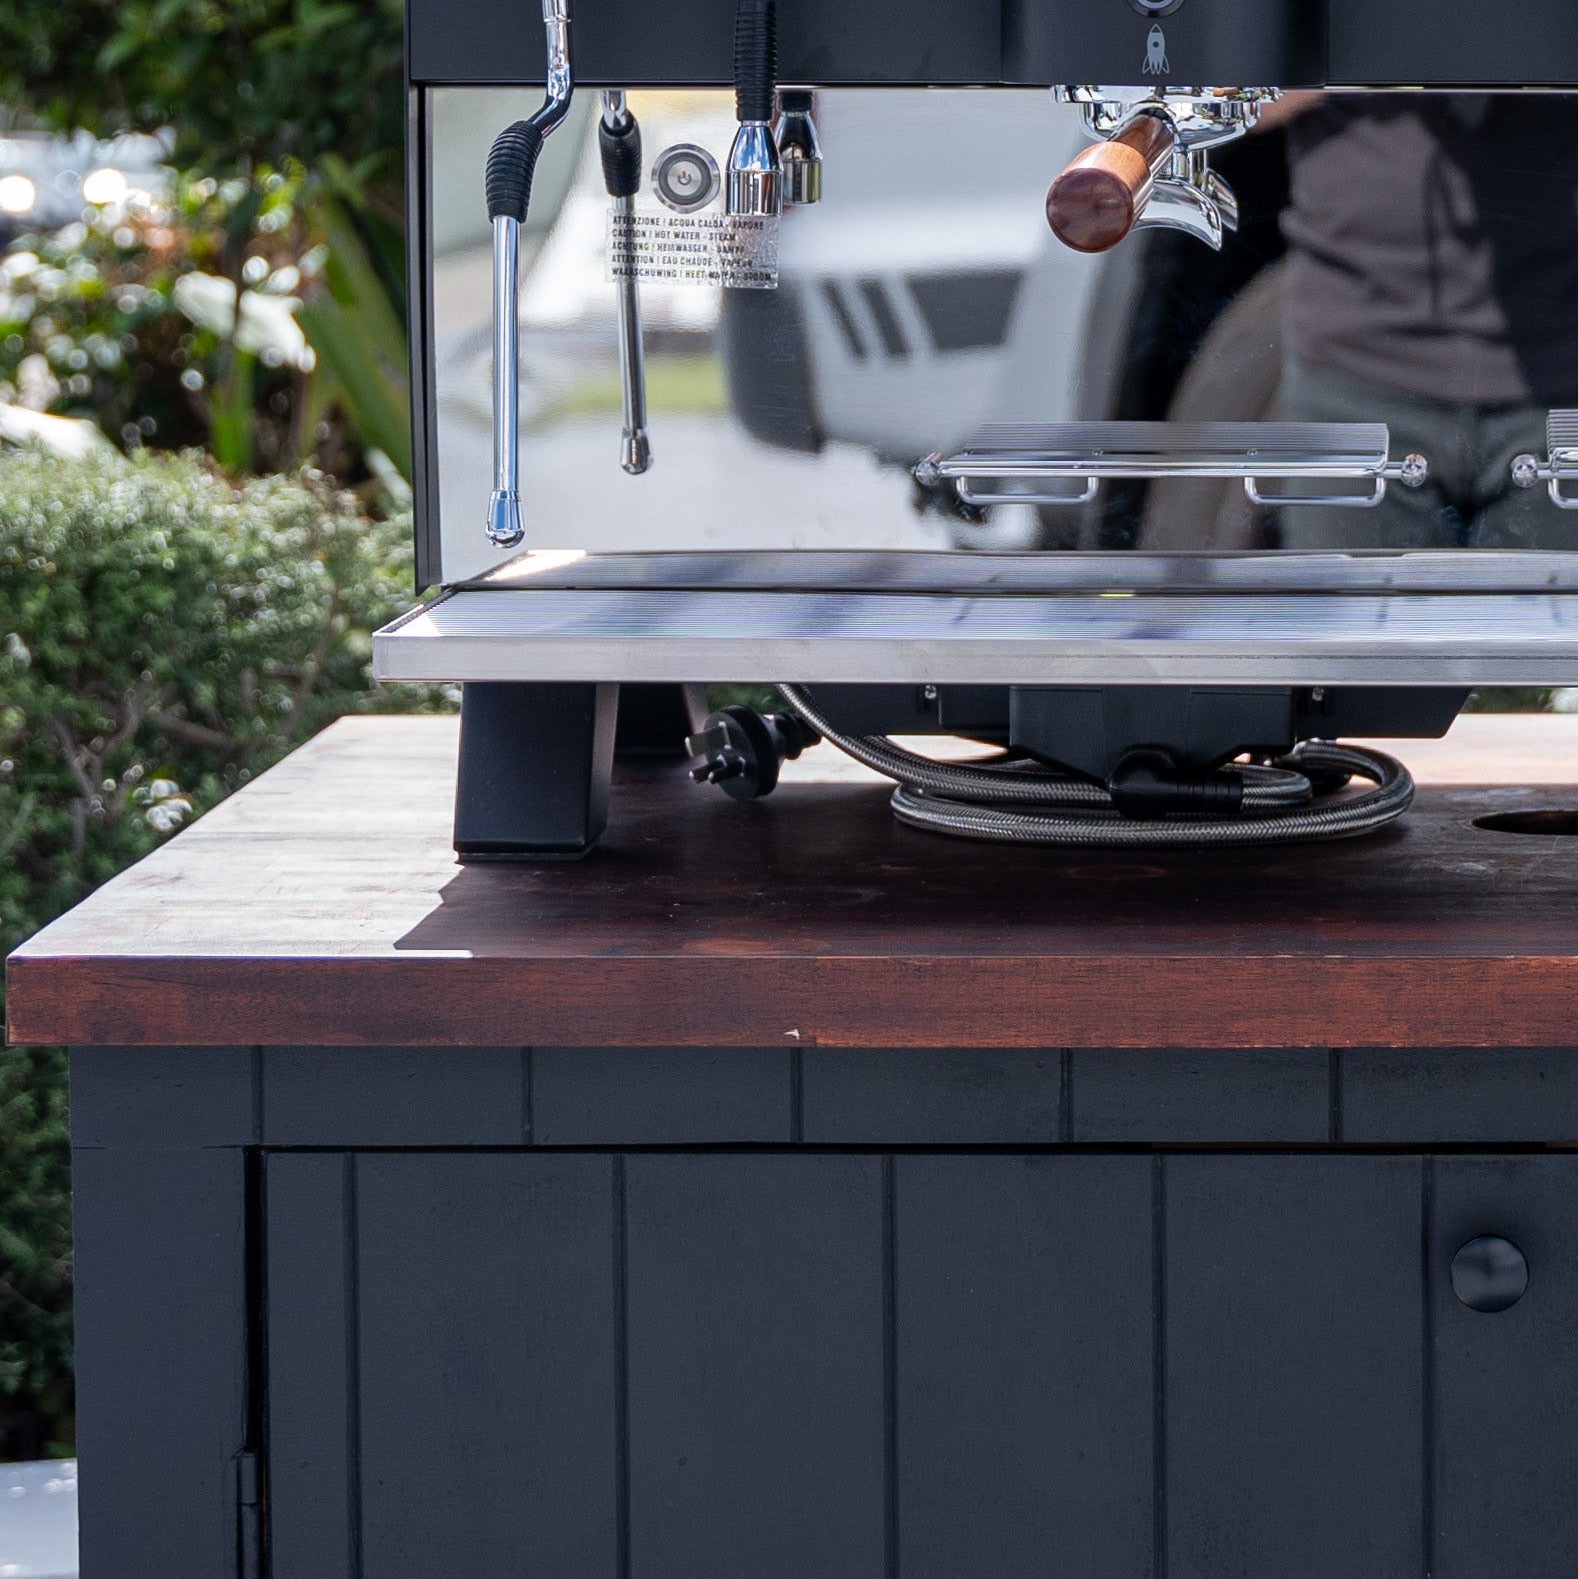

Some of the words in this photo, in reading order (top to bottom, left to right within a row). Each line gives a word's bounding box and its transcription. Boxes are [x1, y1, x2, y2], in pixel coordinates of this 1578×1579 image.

[668, 218, 695, 227] ACQUA
[655, 230, 670, 238] HOT
[674, 231, 700, 240] WATER
[662, 256, 678, 264] EAU
[680, 256, 712, 266] CHAUDE
[685, 270, 705, 278] HEET
